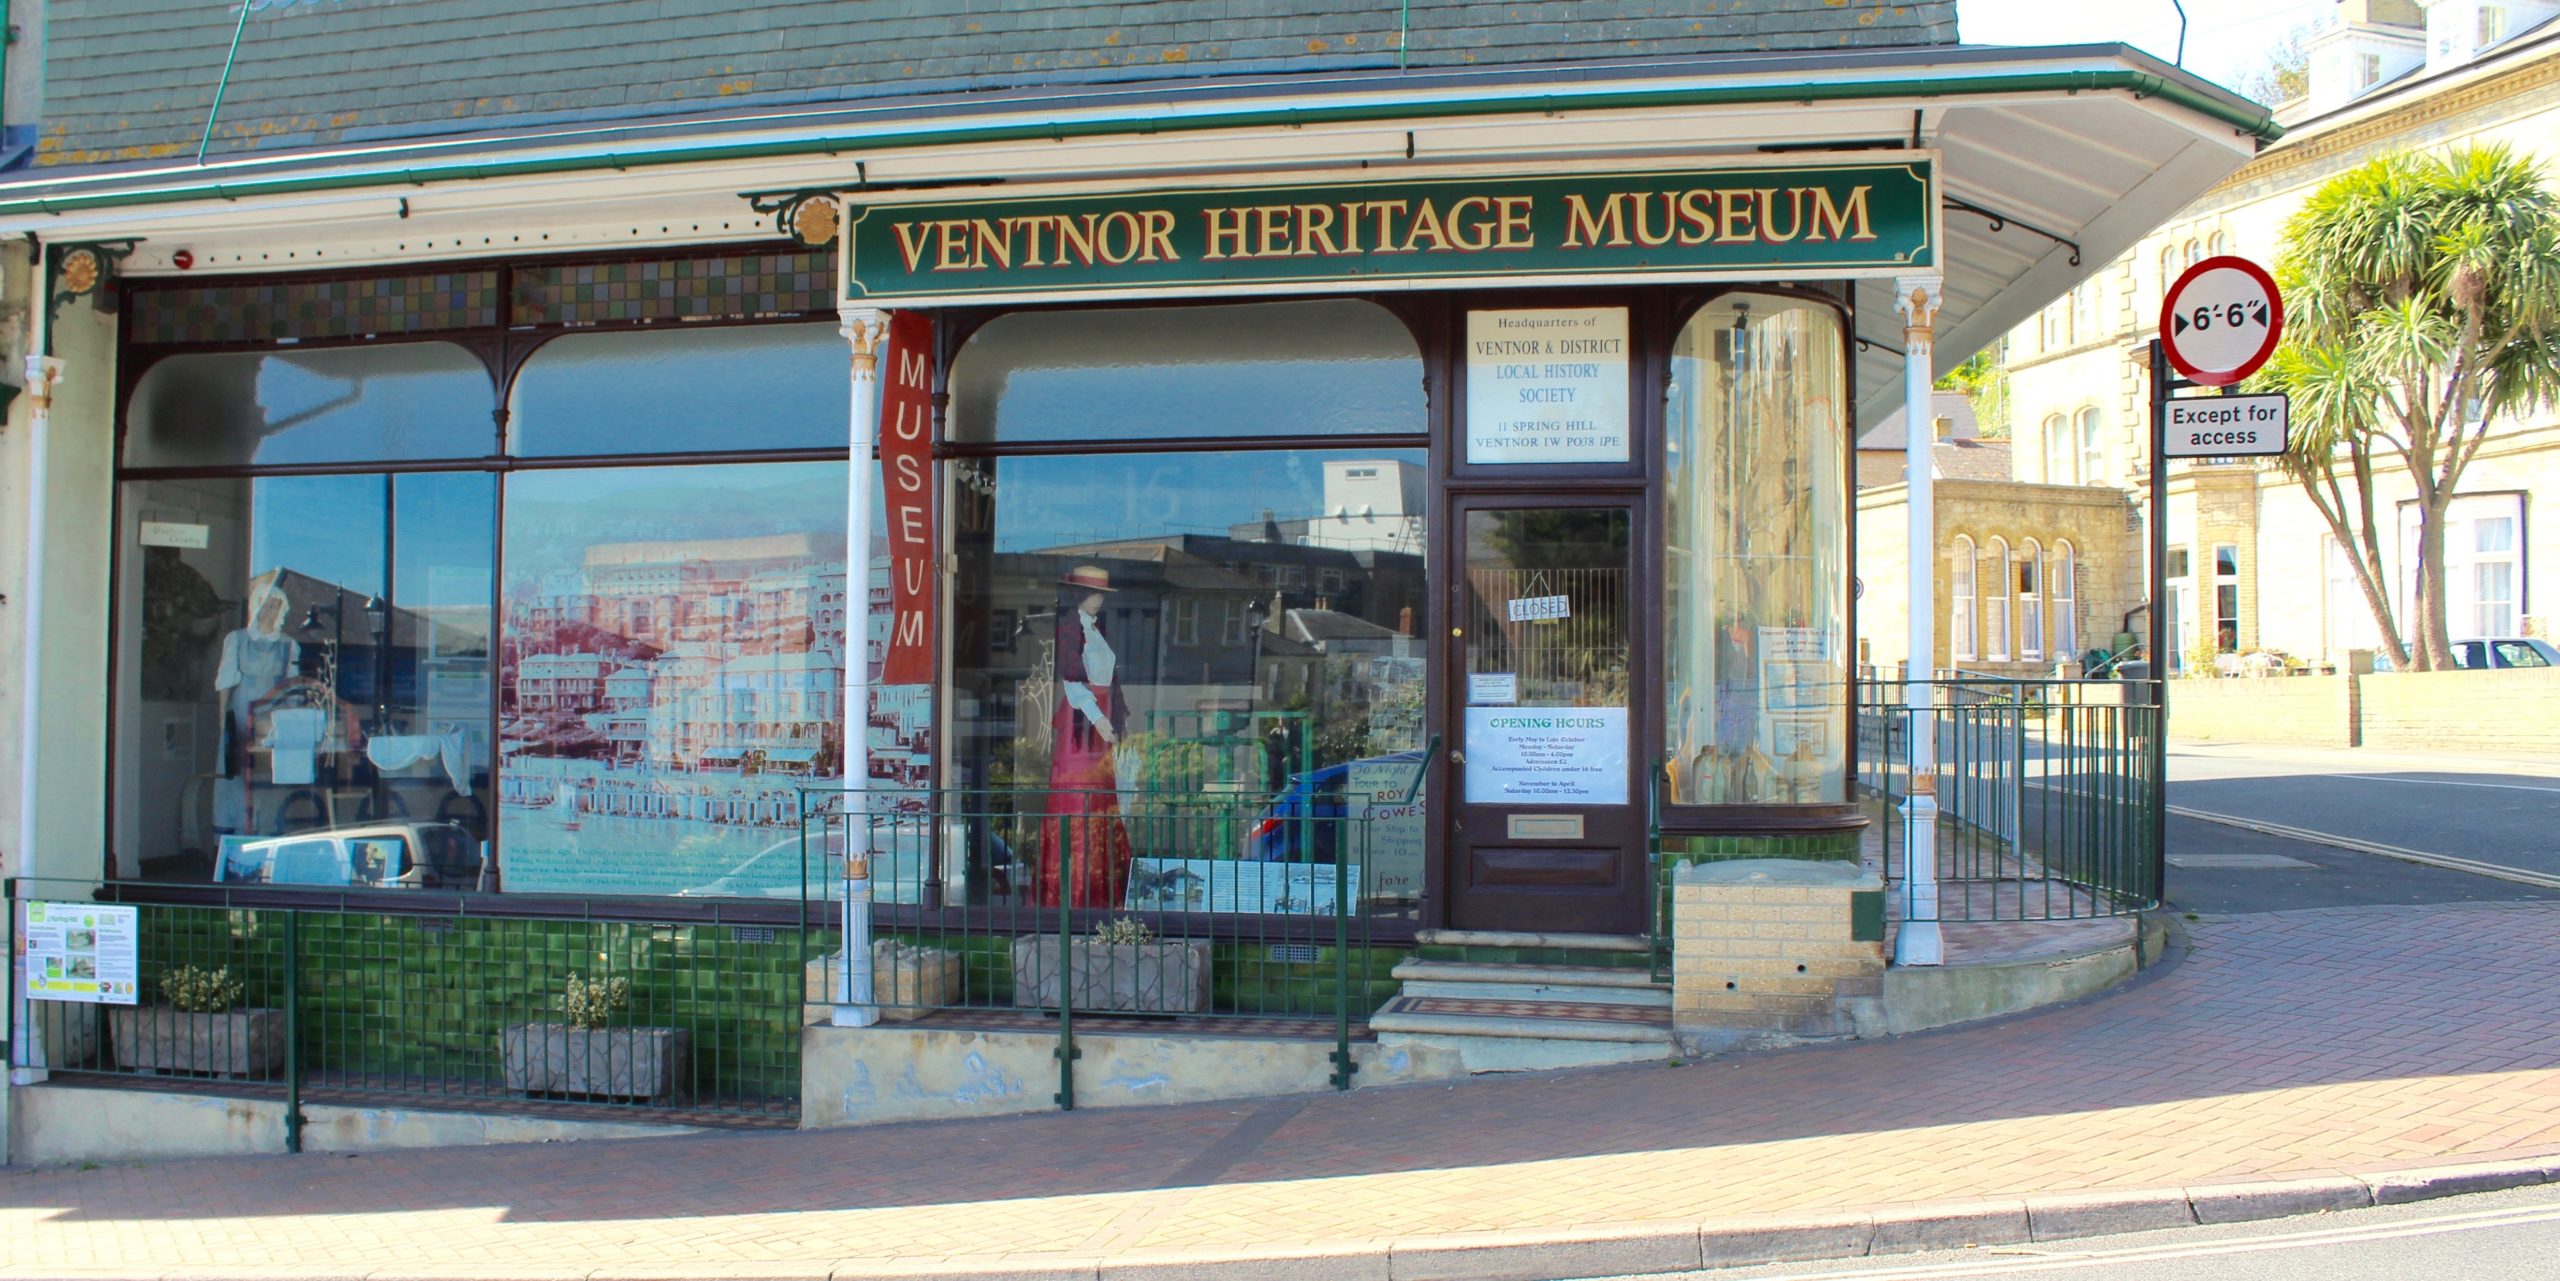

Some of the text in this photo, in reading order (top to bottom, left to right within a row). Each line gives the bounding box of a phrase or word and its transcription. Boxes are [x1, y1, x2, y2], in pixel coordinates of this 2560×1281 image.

[890, 184, 1879, 275] VENTNOR HERITAGE MUSEUM
[1498, 316, 1598, 330] Headquarters of
[1476, 338, 1621, 356] VENTNOR & DISTRICT
[1496, 363, 1600, 379] LOCAL HISTORY
[1519, 387, 1577, 403] SOCIETY
[2172, 404, 2277, 427] Except for
[1498, 420, 1598, 432] 11 SPRING HILL
[1476, 435, 1620, 448] VENTNOR IW PO38 1PE
[2190, 430, 2257, 446] access
[895, 346, 926, 648] MUSEUM
[1513, 600, 1568, 617] CLOSED
[1489, 717, 1605, 728] OPENING HOURS
[1558, 780, 1575, 788] April
[1381, 835, 1422, 846] Shipping
[1376, 871, 1409, 898] fare
